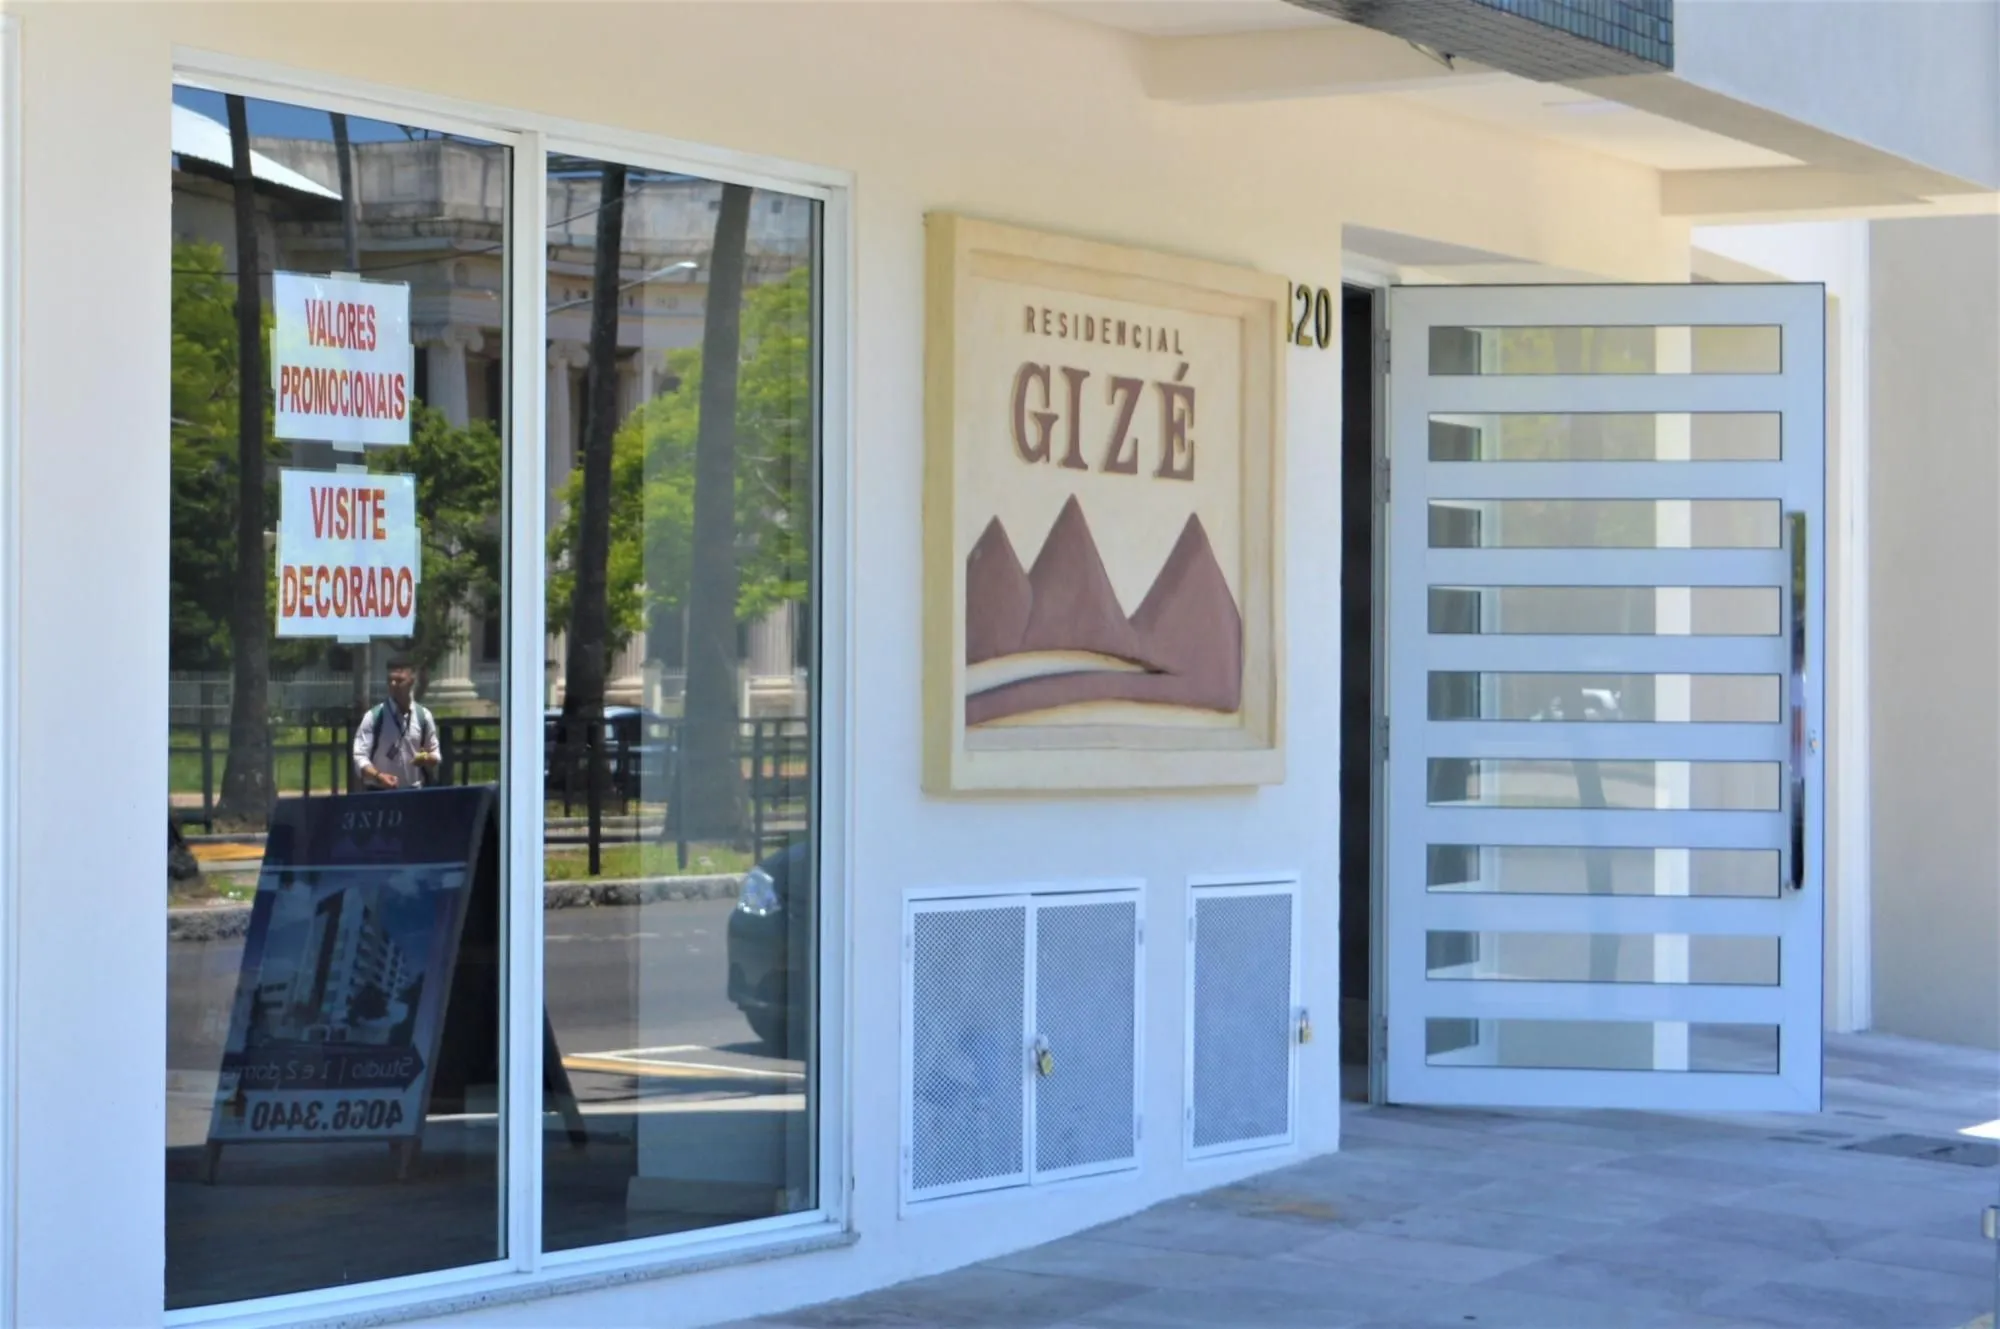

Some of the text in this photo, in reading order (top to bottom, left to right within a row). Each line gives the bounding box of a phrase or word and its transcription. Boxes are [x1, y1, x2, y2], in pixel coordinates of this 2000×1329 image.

[305, 298, 376, 351] VALORES
[1024, 305, 1184, 355] RESIDENCIAL
[280, 365, 405, 420] PROMOCIONAIS
[1011, 361, 1196, 482] GIZÉ
[310, 486, 386, 540] VISITE
[282, 565, 413, 618] DECORADO
